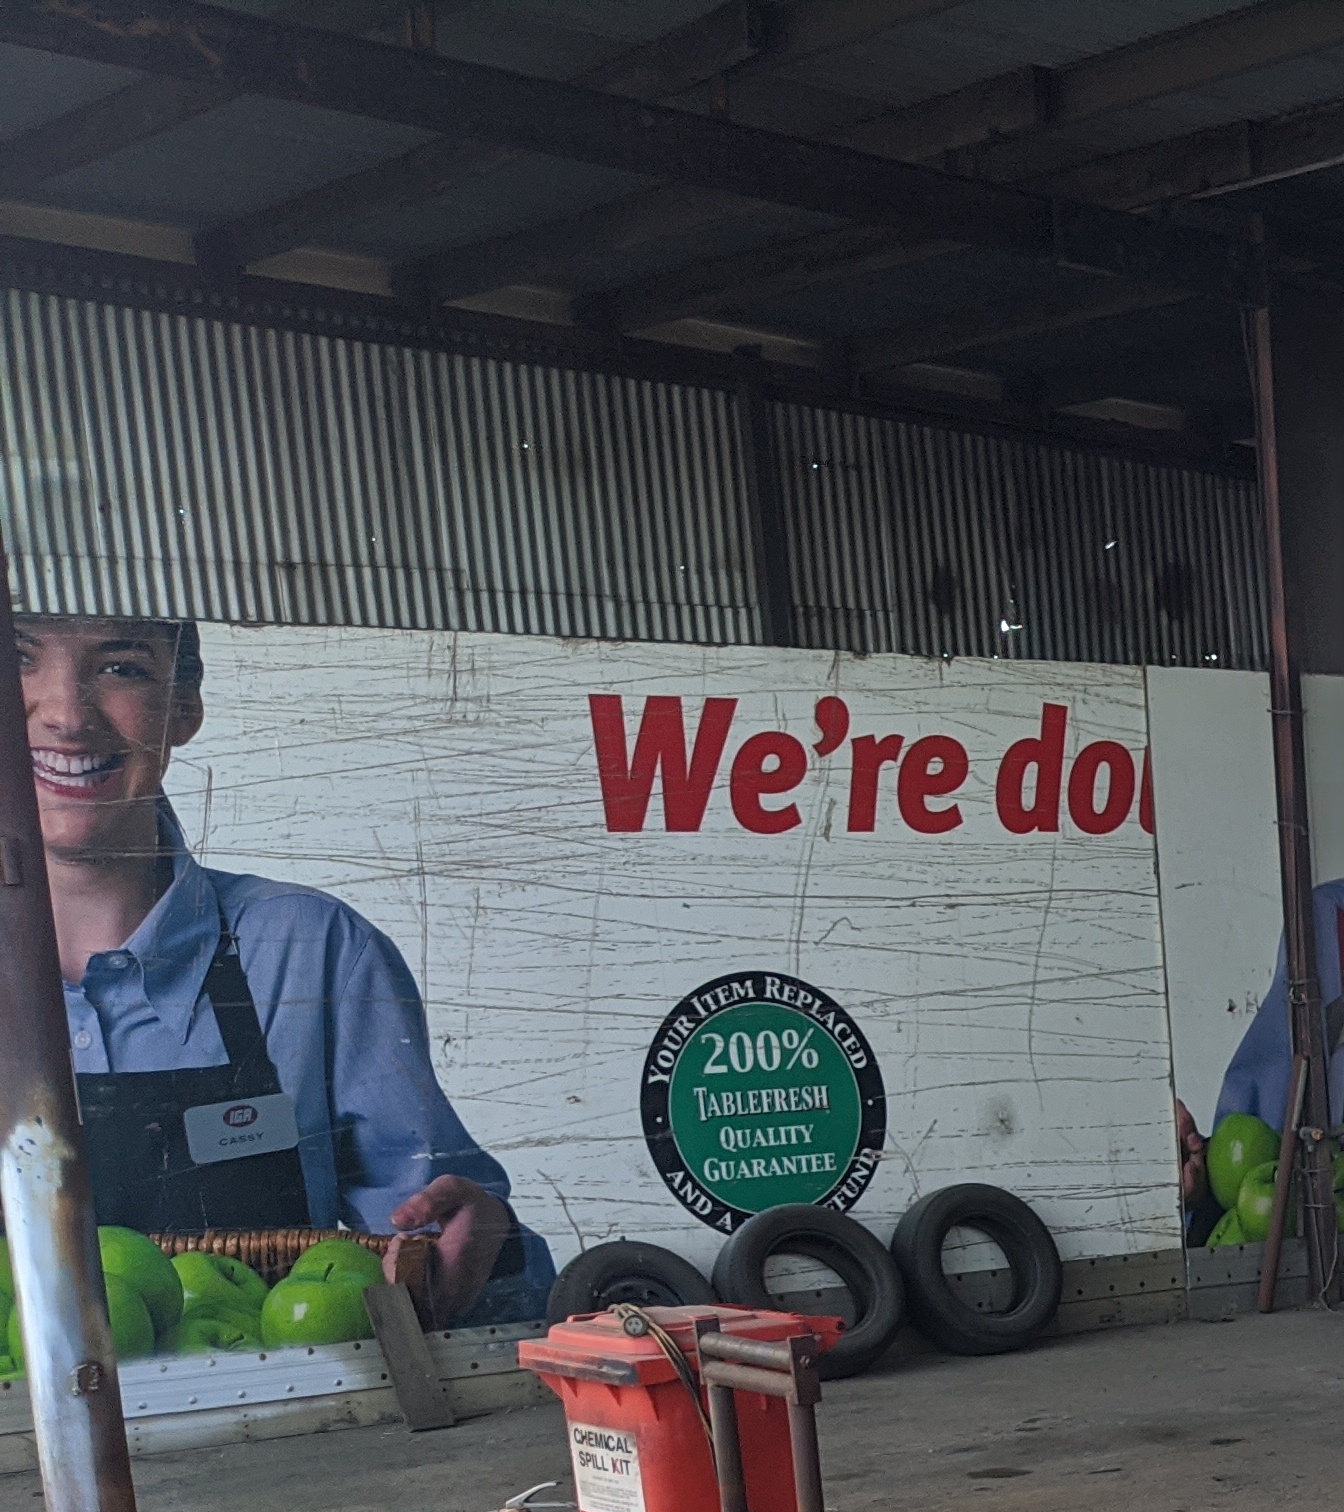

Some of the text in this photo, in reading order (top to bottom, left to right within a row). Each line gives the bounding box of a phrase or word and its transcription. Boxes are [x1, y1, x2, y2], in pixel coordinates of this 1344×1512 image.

[588, 693, 969, 834] We're
[647, 976, 868, 1085] YOUR ITEM REPLACED
[701, 1028, 819, 1075] 200%
[229, 1107, 253, 1125] IGA
[693, 1085, 829, 1122] TABLEFRESH
[218, 1132, 264, 1146] CASSY
[719, 1124, 813, 1153] QUALITY
[703, 1152, 837, 1182] GUARANTEE
[666, 1170, 712, 1216] AND
[716, 1217, 733, 1231] A
[573, 1427, 633, 1454] CHEMICAL
[578, 1451, 631, 1475] SPILL KIT
